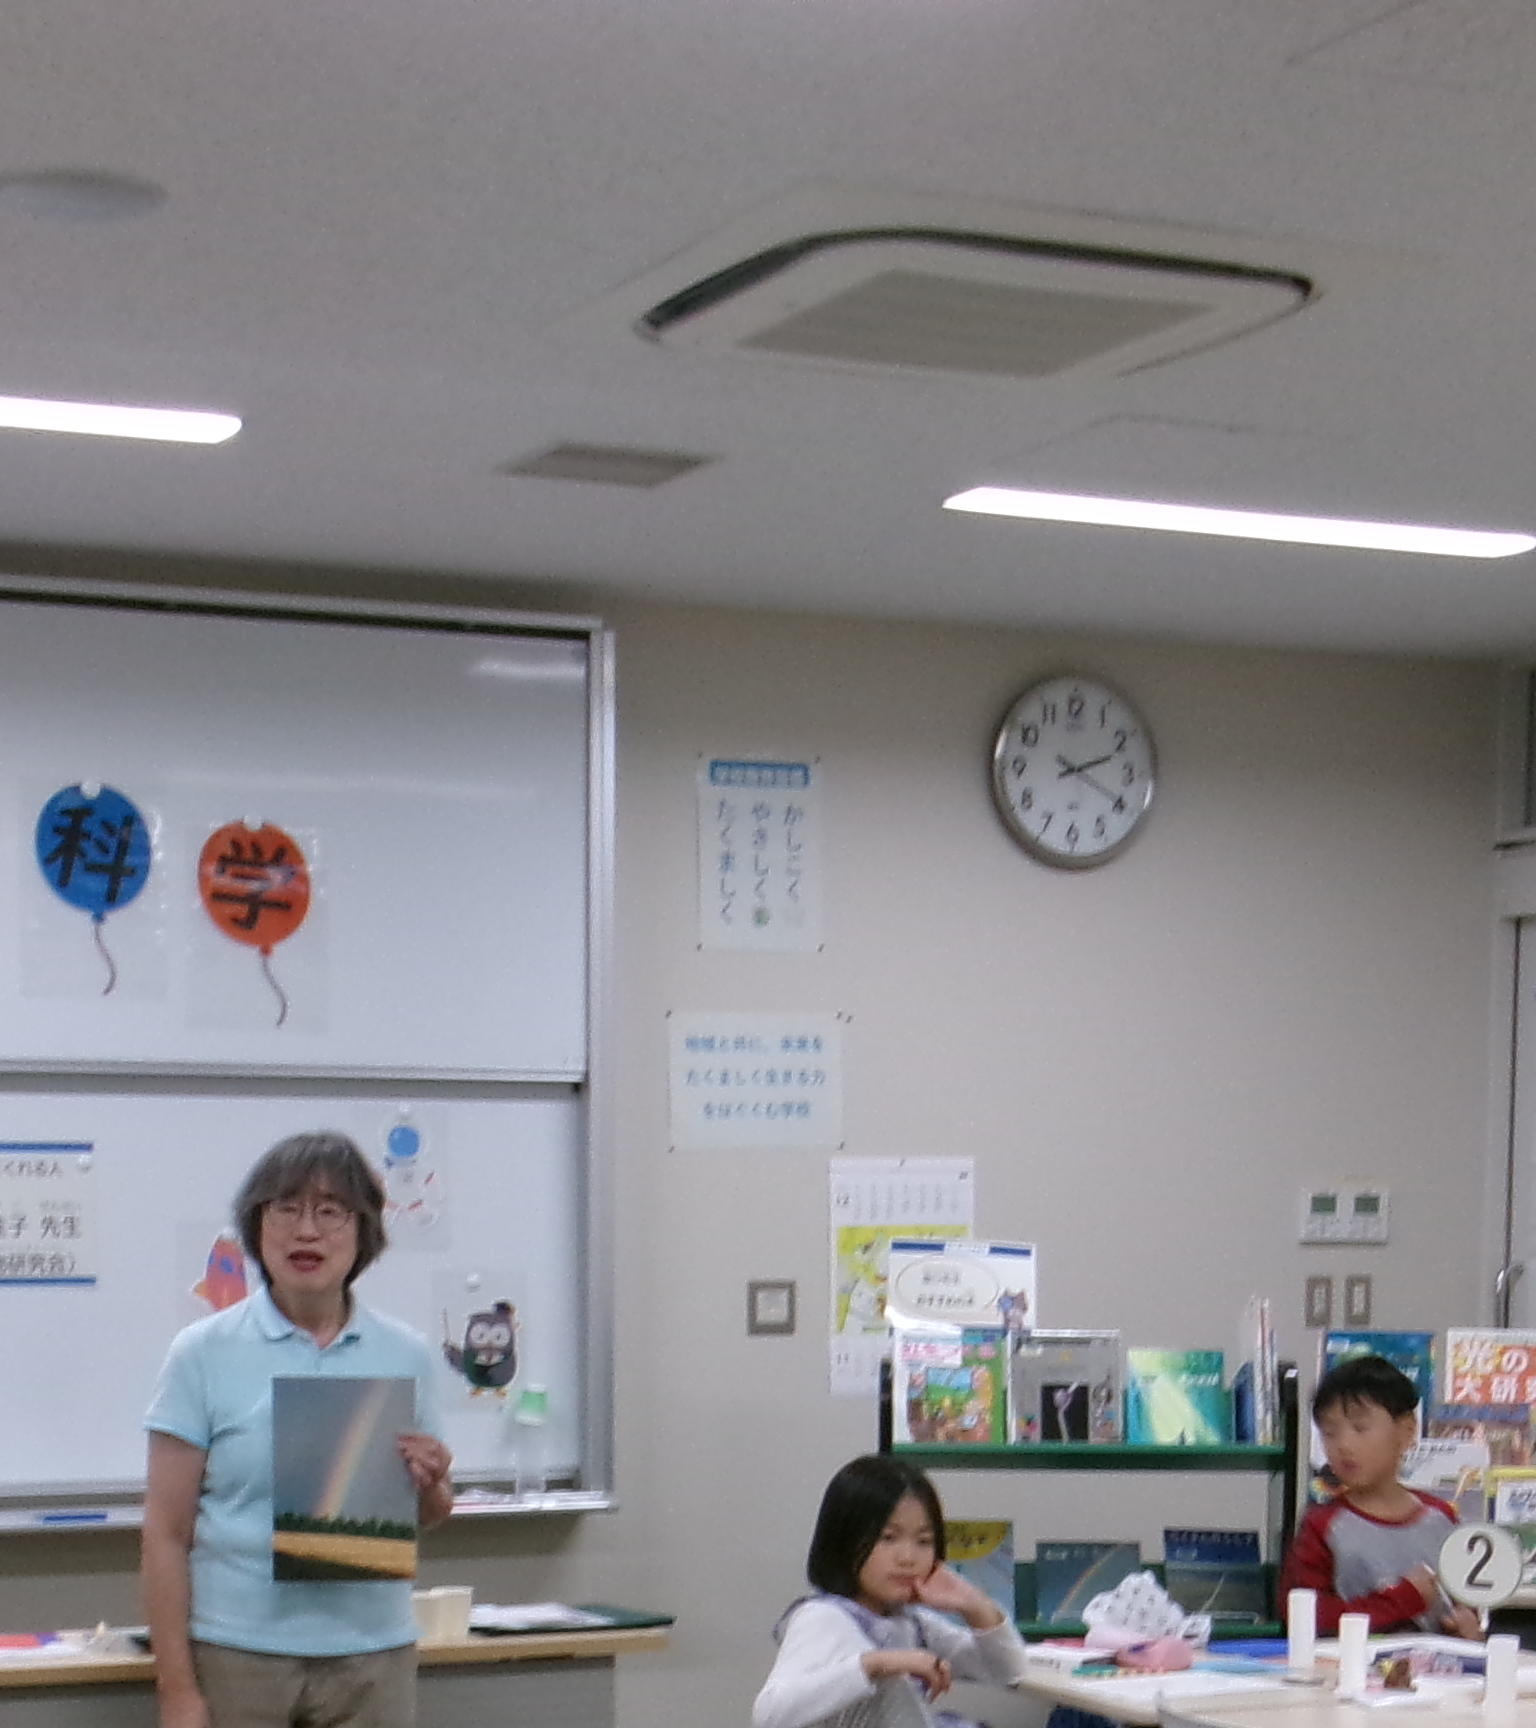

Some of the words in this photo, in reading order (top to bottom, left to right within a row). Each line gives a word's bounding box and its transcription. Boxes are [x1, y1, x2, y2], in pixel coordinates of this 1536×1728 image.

[41, 1215, 82, 1239] 先生
[1455, 1338, 1529, 1374] 光の
[1464, 1531, 1495, 1589] 2
